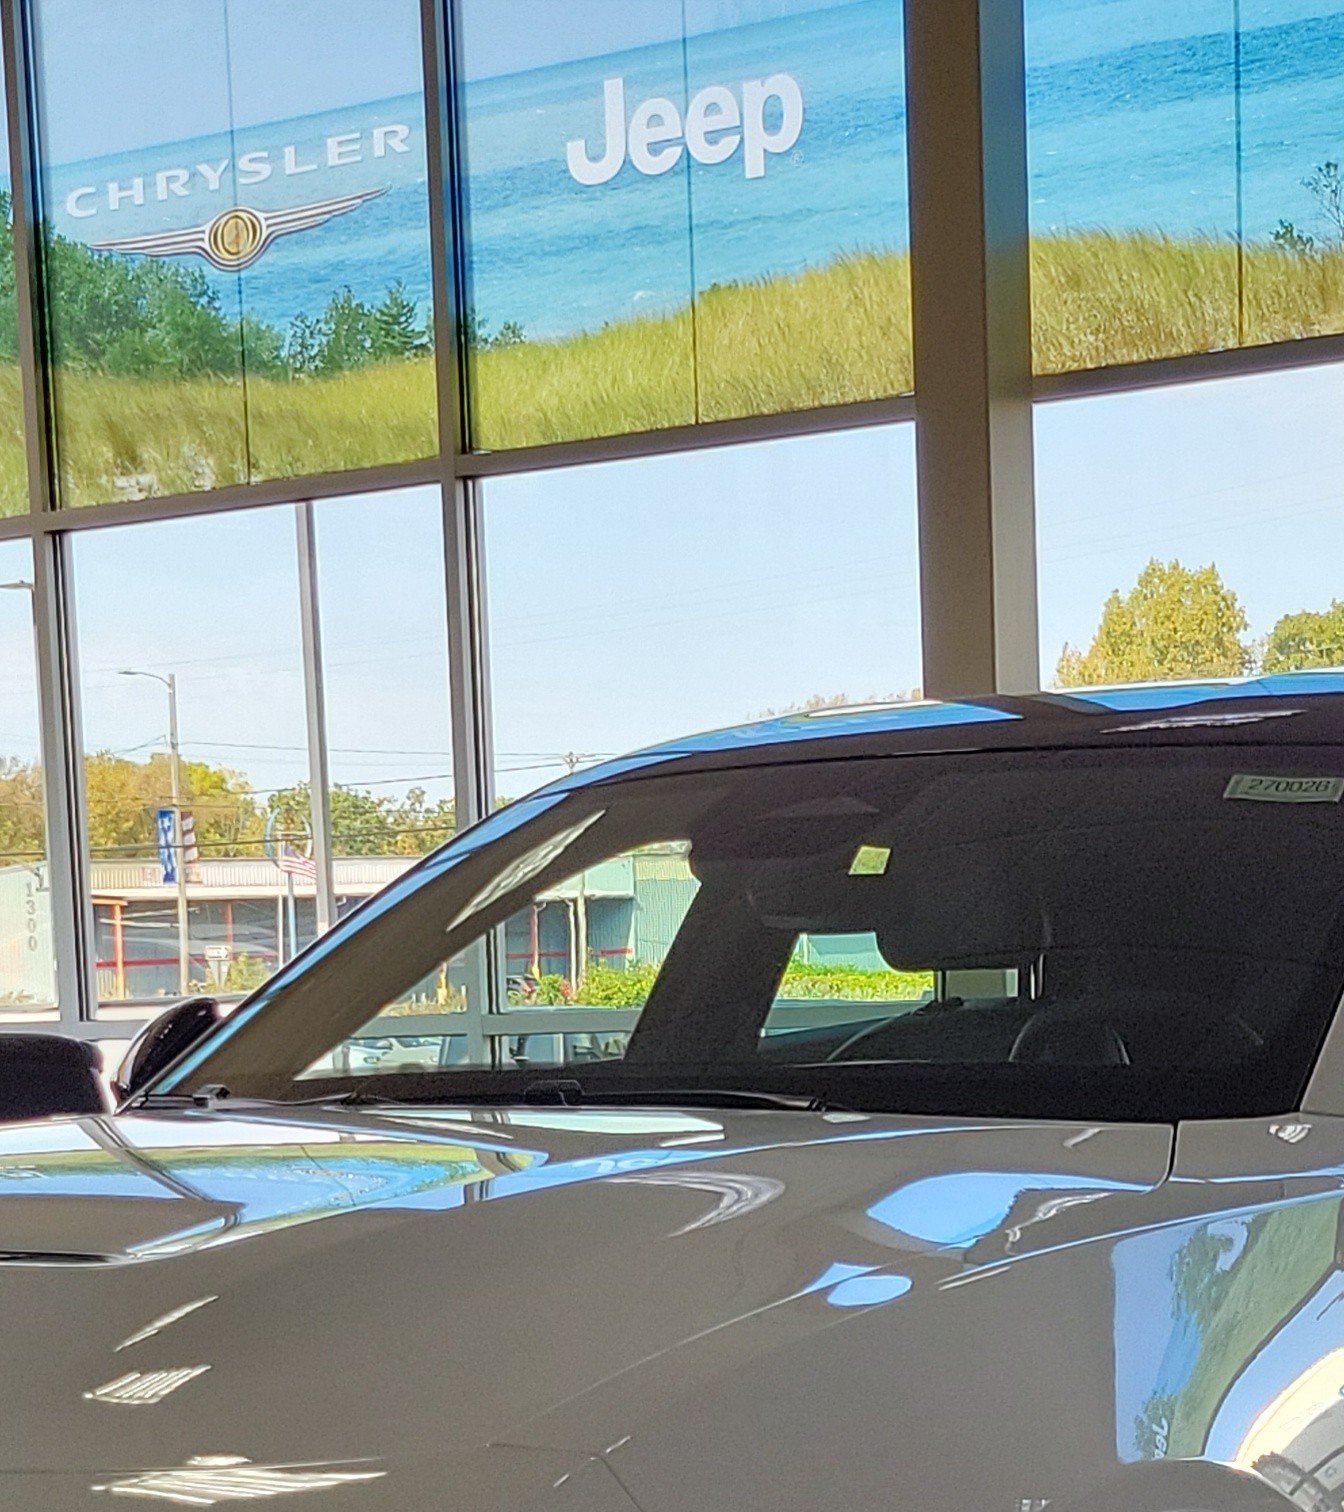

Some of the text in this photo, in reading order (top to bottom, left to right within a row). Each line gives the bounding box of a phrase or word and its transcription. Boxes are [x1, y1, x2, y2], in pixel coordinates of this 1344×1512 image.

[66, 124, 411, 218] CHRYSLER
[566, 73, 803, 186] Jeep
[25, 881, 38, 952] 1300
